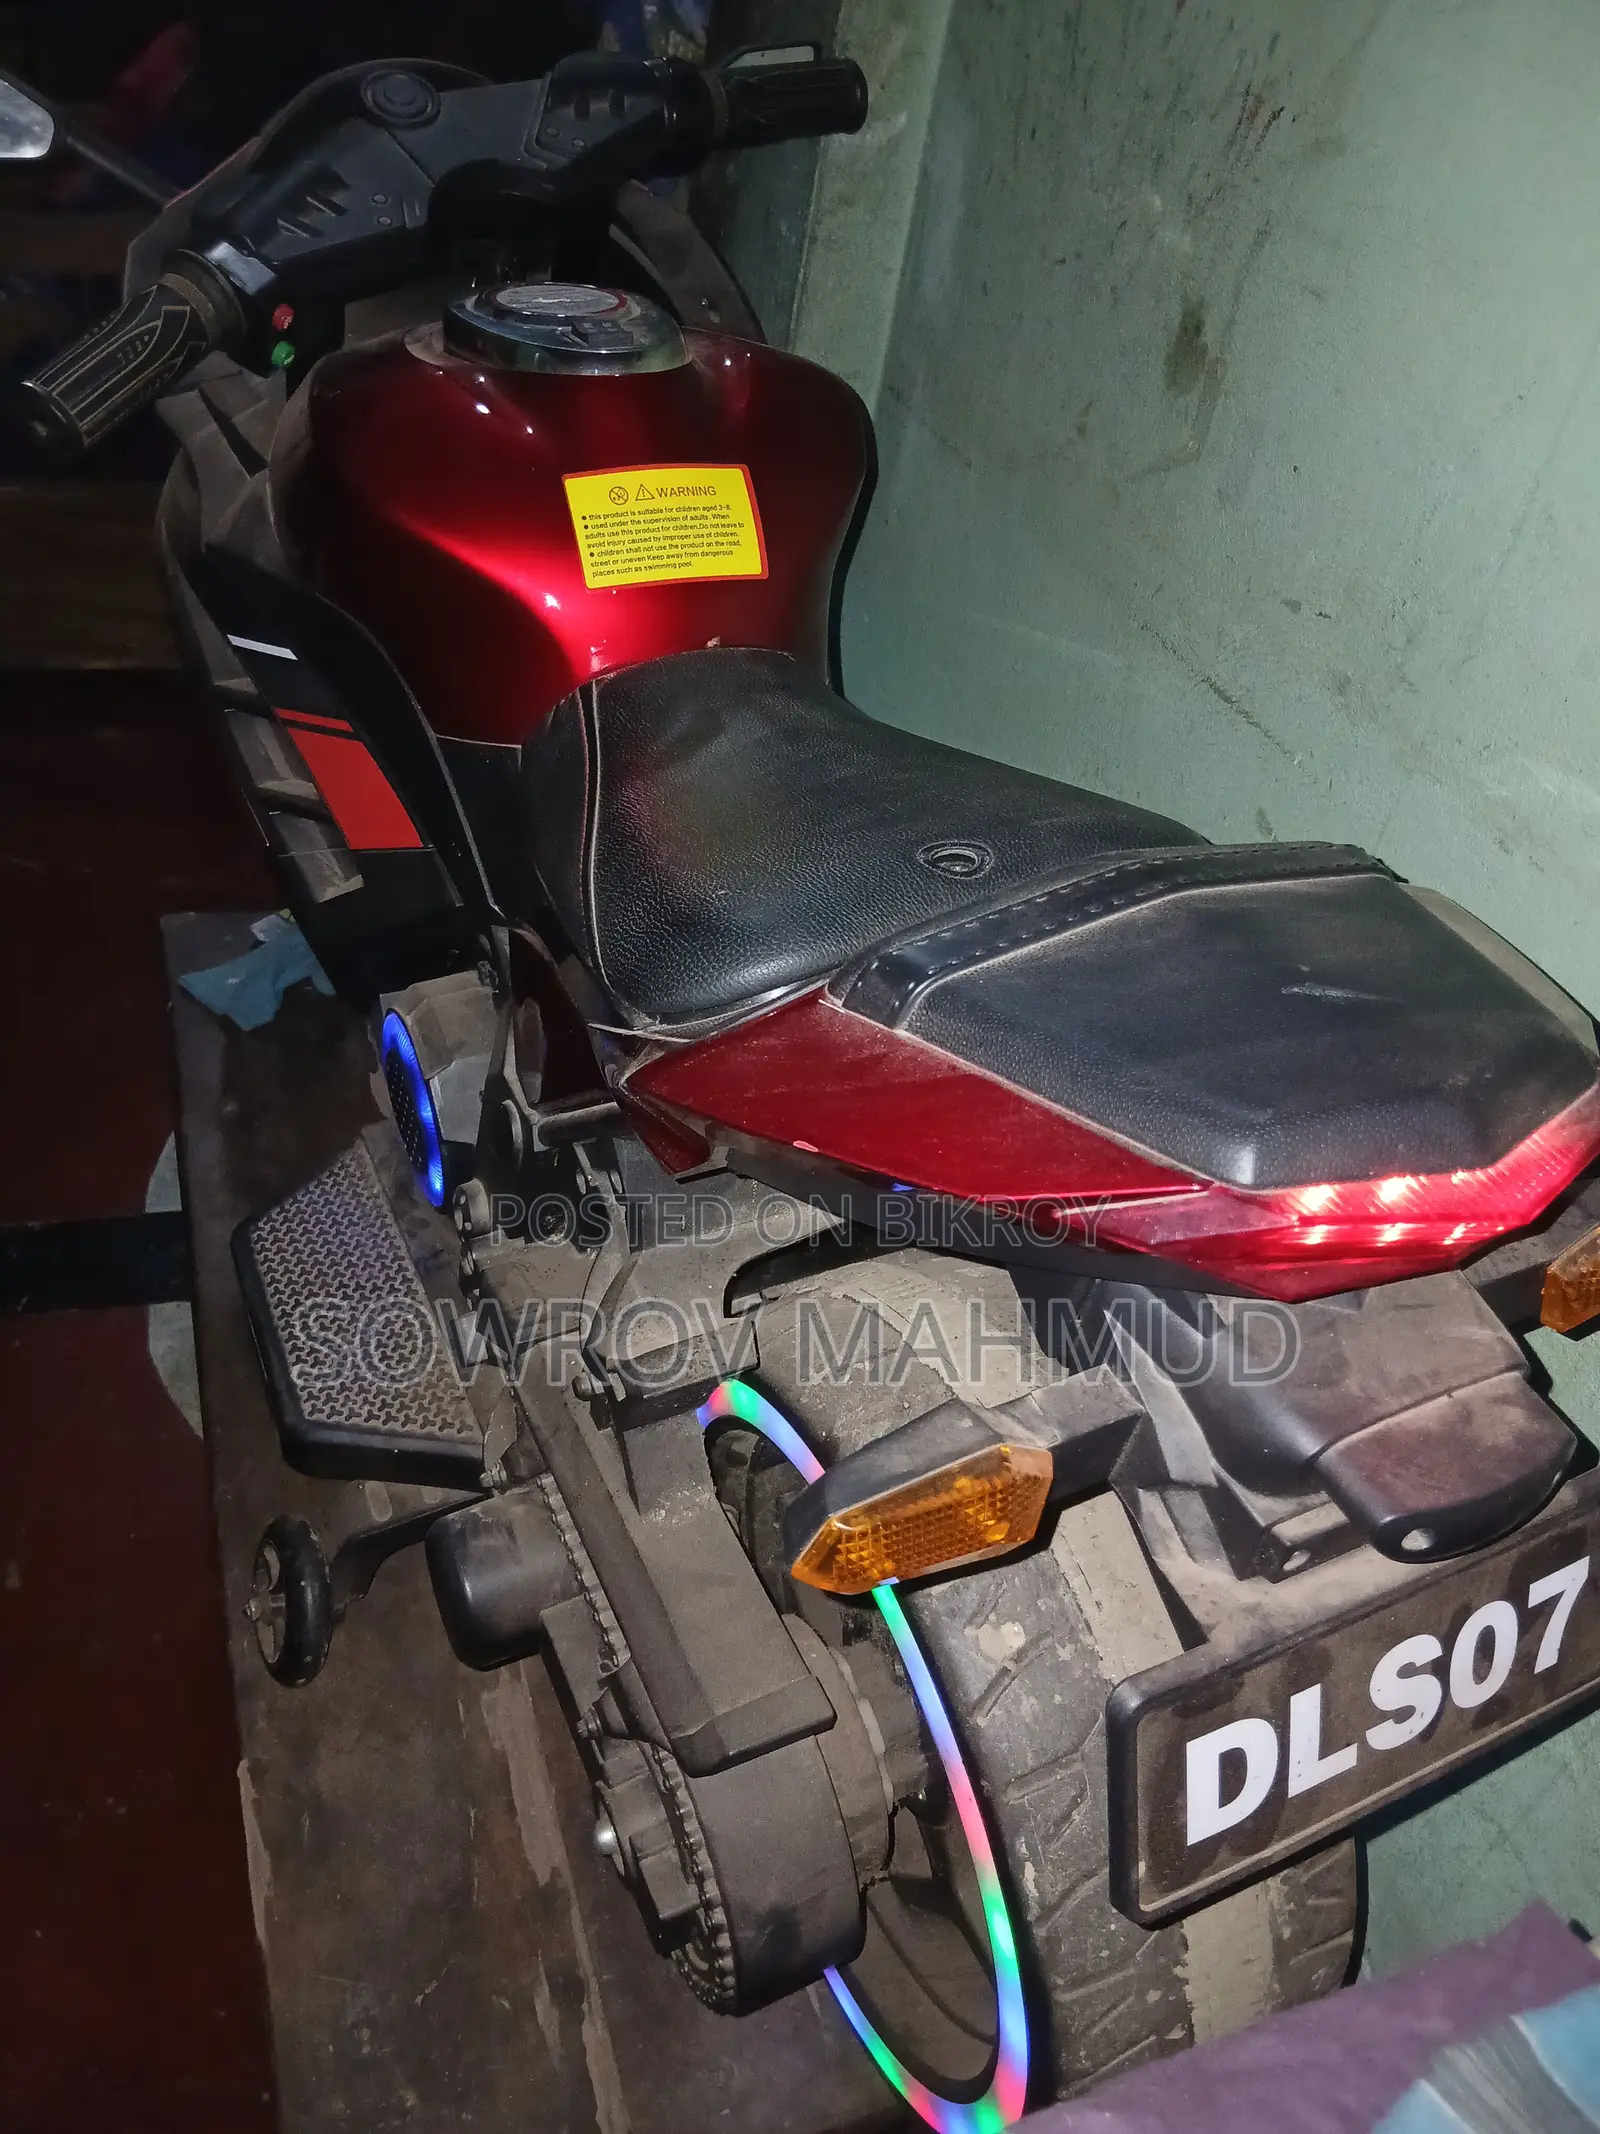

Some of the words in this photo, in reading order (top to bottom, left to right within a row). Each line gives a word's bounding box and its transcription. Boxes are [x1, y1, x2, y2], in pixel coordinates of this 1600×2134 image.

[656, 486, 716, 497] WARNING
[603, 511, 629, 520] product
[675, 505, 701, 513] children
[643, 516, 681, 524] supervision
[635, 526, 661, 535] product
[587, 541, 606, 549] avoid
[607, 539, 626, 547] injury
[653, 535, 662, 543] by
[662, 533, 692, 541] improper
[597, 548, 625, 557] children
[680, 541, 705, 549] product
[590, 559, 611, 567] street
[646, 553, 665, 561] Keep
[666, 552, 684, 560] away
[700, 549, 733, 557] dangerous
[593, 569, 616, 578] places
[616, 566, 633, 574] such
[644, 562, 678, 570] swimming
[1185, 1555, 1590, 1846] DLS07
